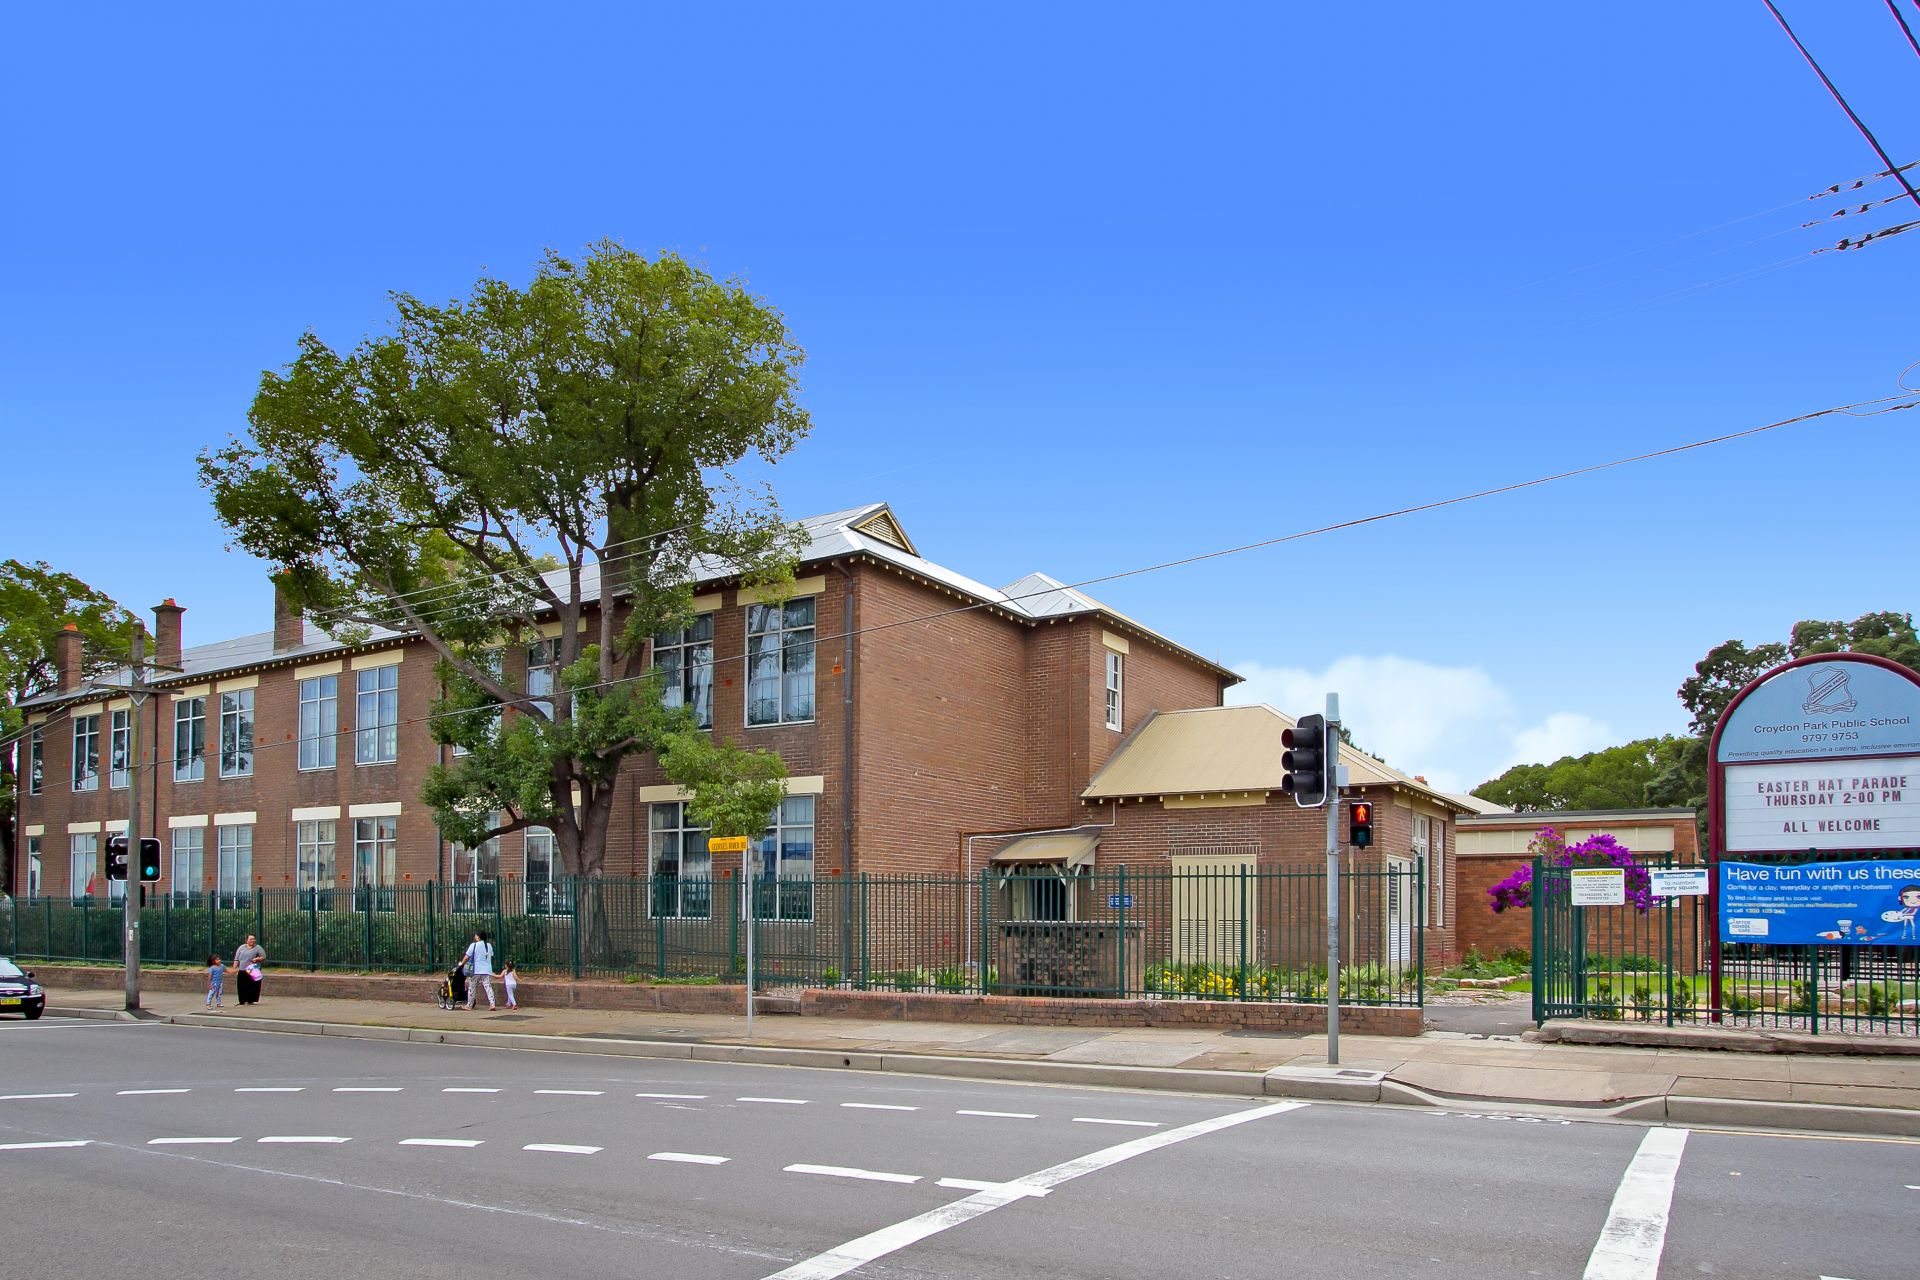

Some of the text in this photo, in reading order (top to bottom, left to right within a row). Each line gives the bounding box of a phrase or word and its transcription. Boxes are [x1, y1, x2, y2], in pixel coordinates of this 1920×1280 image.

[1832, 675, 1845, 685] PARK
[1754, 716, 1910, 734] Croydon Park Public School
[1801, 732, 1859, 742] 9797 9753
[1758, 776, 1907, 793] EASTER HAT PARADE
[1766, 790, 1901, 806] THURSDAY 2-00 PM
[1783, 819, 1880, 833] ALL WELCOME
[1727, 868, 1769, 880] Have
[1774, 867, 1801, 880] fun
[1806, 867, 1842, 880] with
[1848, 868, 1869, 880] us
